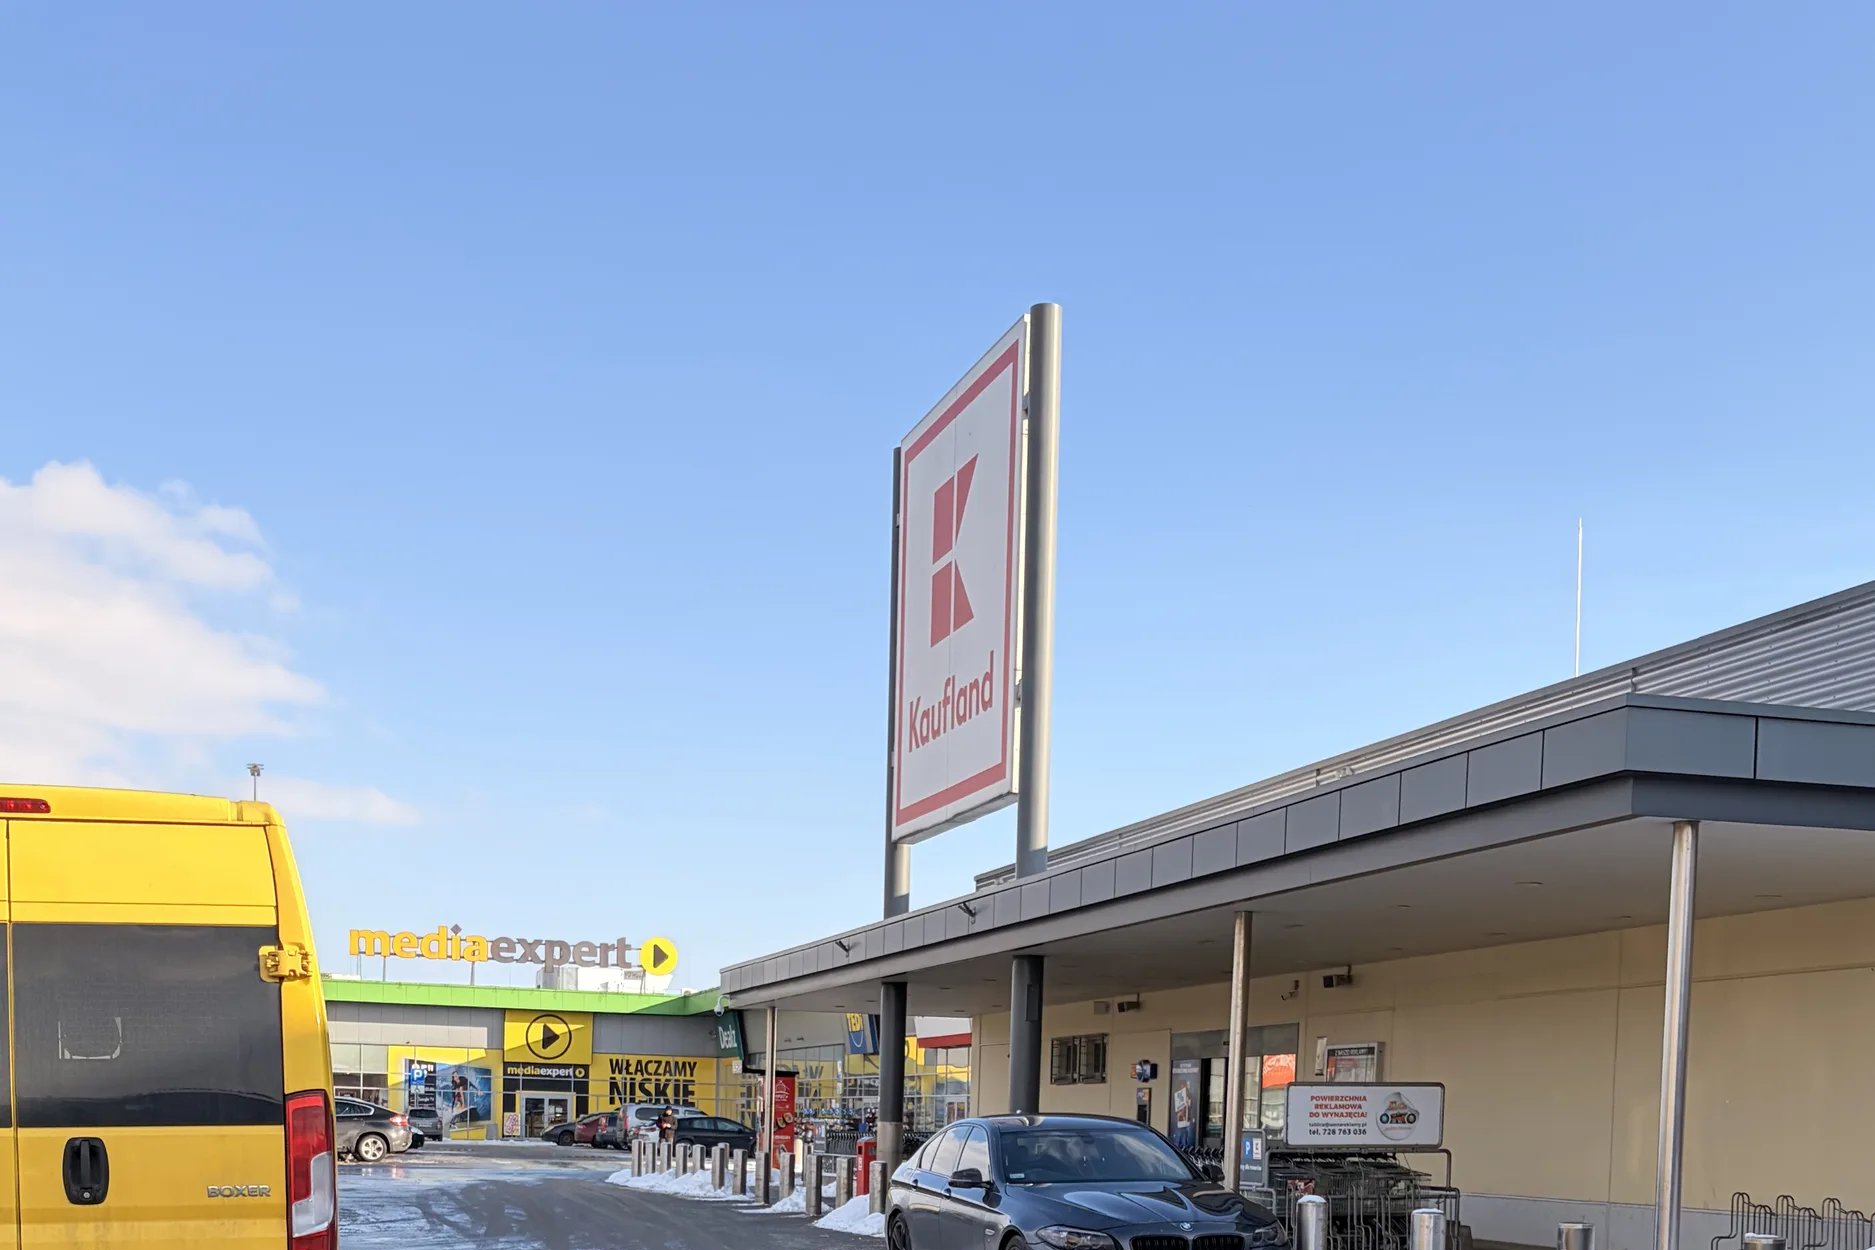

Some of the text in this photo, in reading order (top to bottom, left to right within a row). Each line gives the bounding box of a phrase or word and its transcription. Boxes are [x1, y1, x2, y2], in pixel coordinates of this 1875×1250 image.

[908, 650, 995, 754] Kaufland
[349, 924, 632, 973] mediaexpert
[718, 1024, 738, 1050] Dealz
[507, 1065, 573, 1078] mediaexpert
[609, 1058, 697, 1077] WŁĄCZAMY
[609, 1076, 696, 1107] NISKIE
[1321, 1111, 1368, 1119] WYNAJĘCIA!
[1308, 1128, 1367, 1136] tel. 728 763 036
[207, 1184, 272, 1198] BOXER
